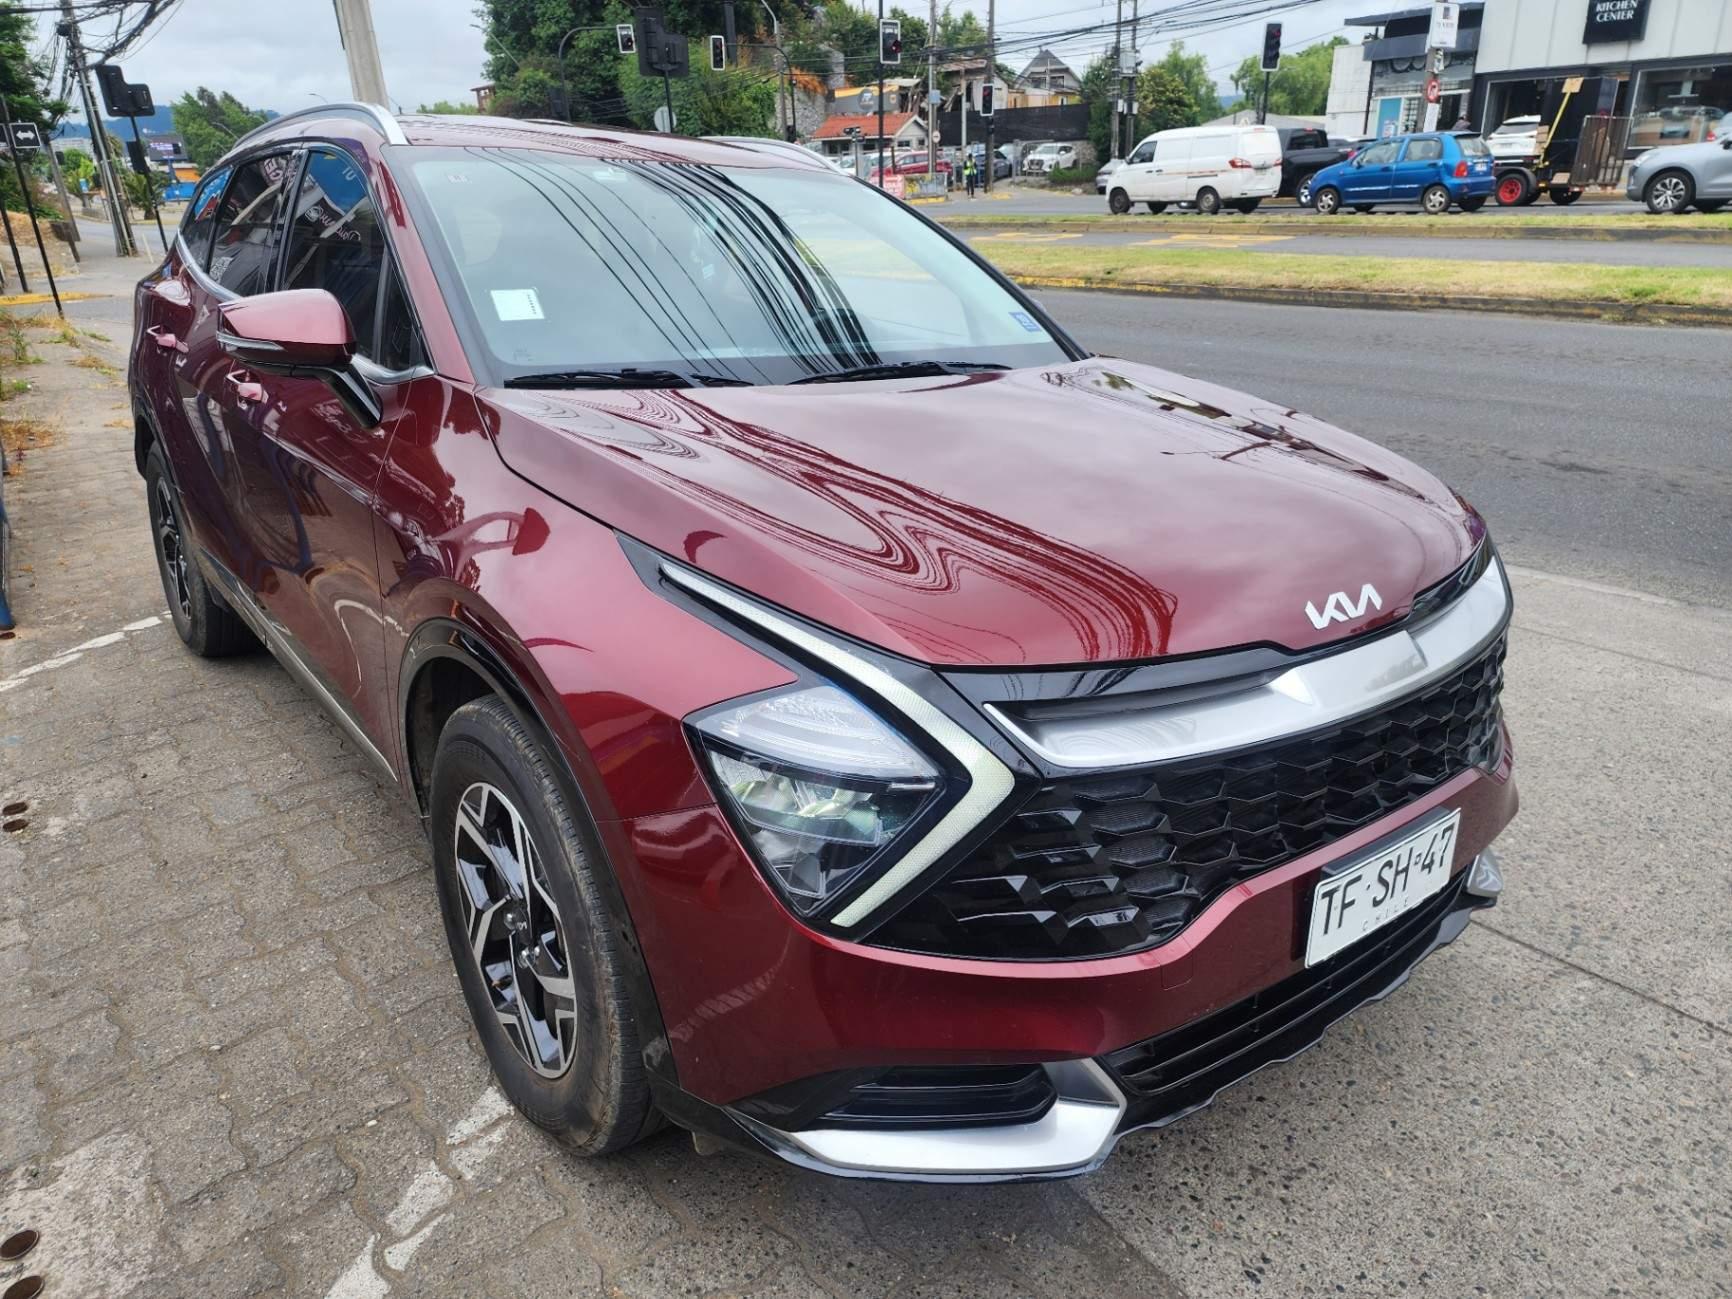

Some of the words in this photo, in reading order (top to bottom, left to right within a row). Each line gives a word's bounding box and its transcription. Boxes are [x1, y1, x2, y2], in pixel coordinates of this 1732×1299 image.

[1596, 0, 1638, 12] KITCHEN
[1596, 10, 1634, 22] CENTER
[1304, 583, 1383, 630] KIA
